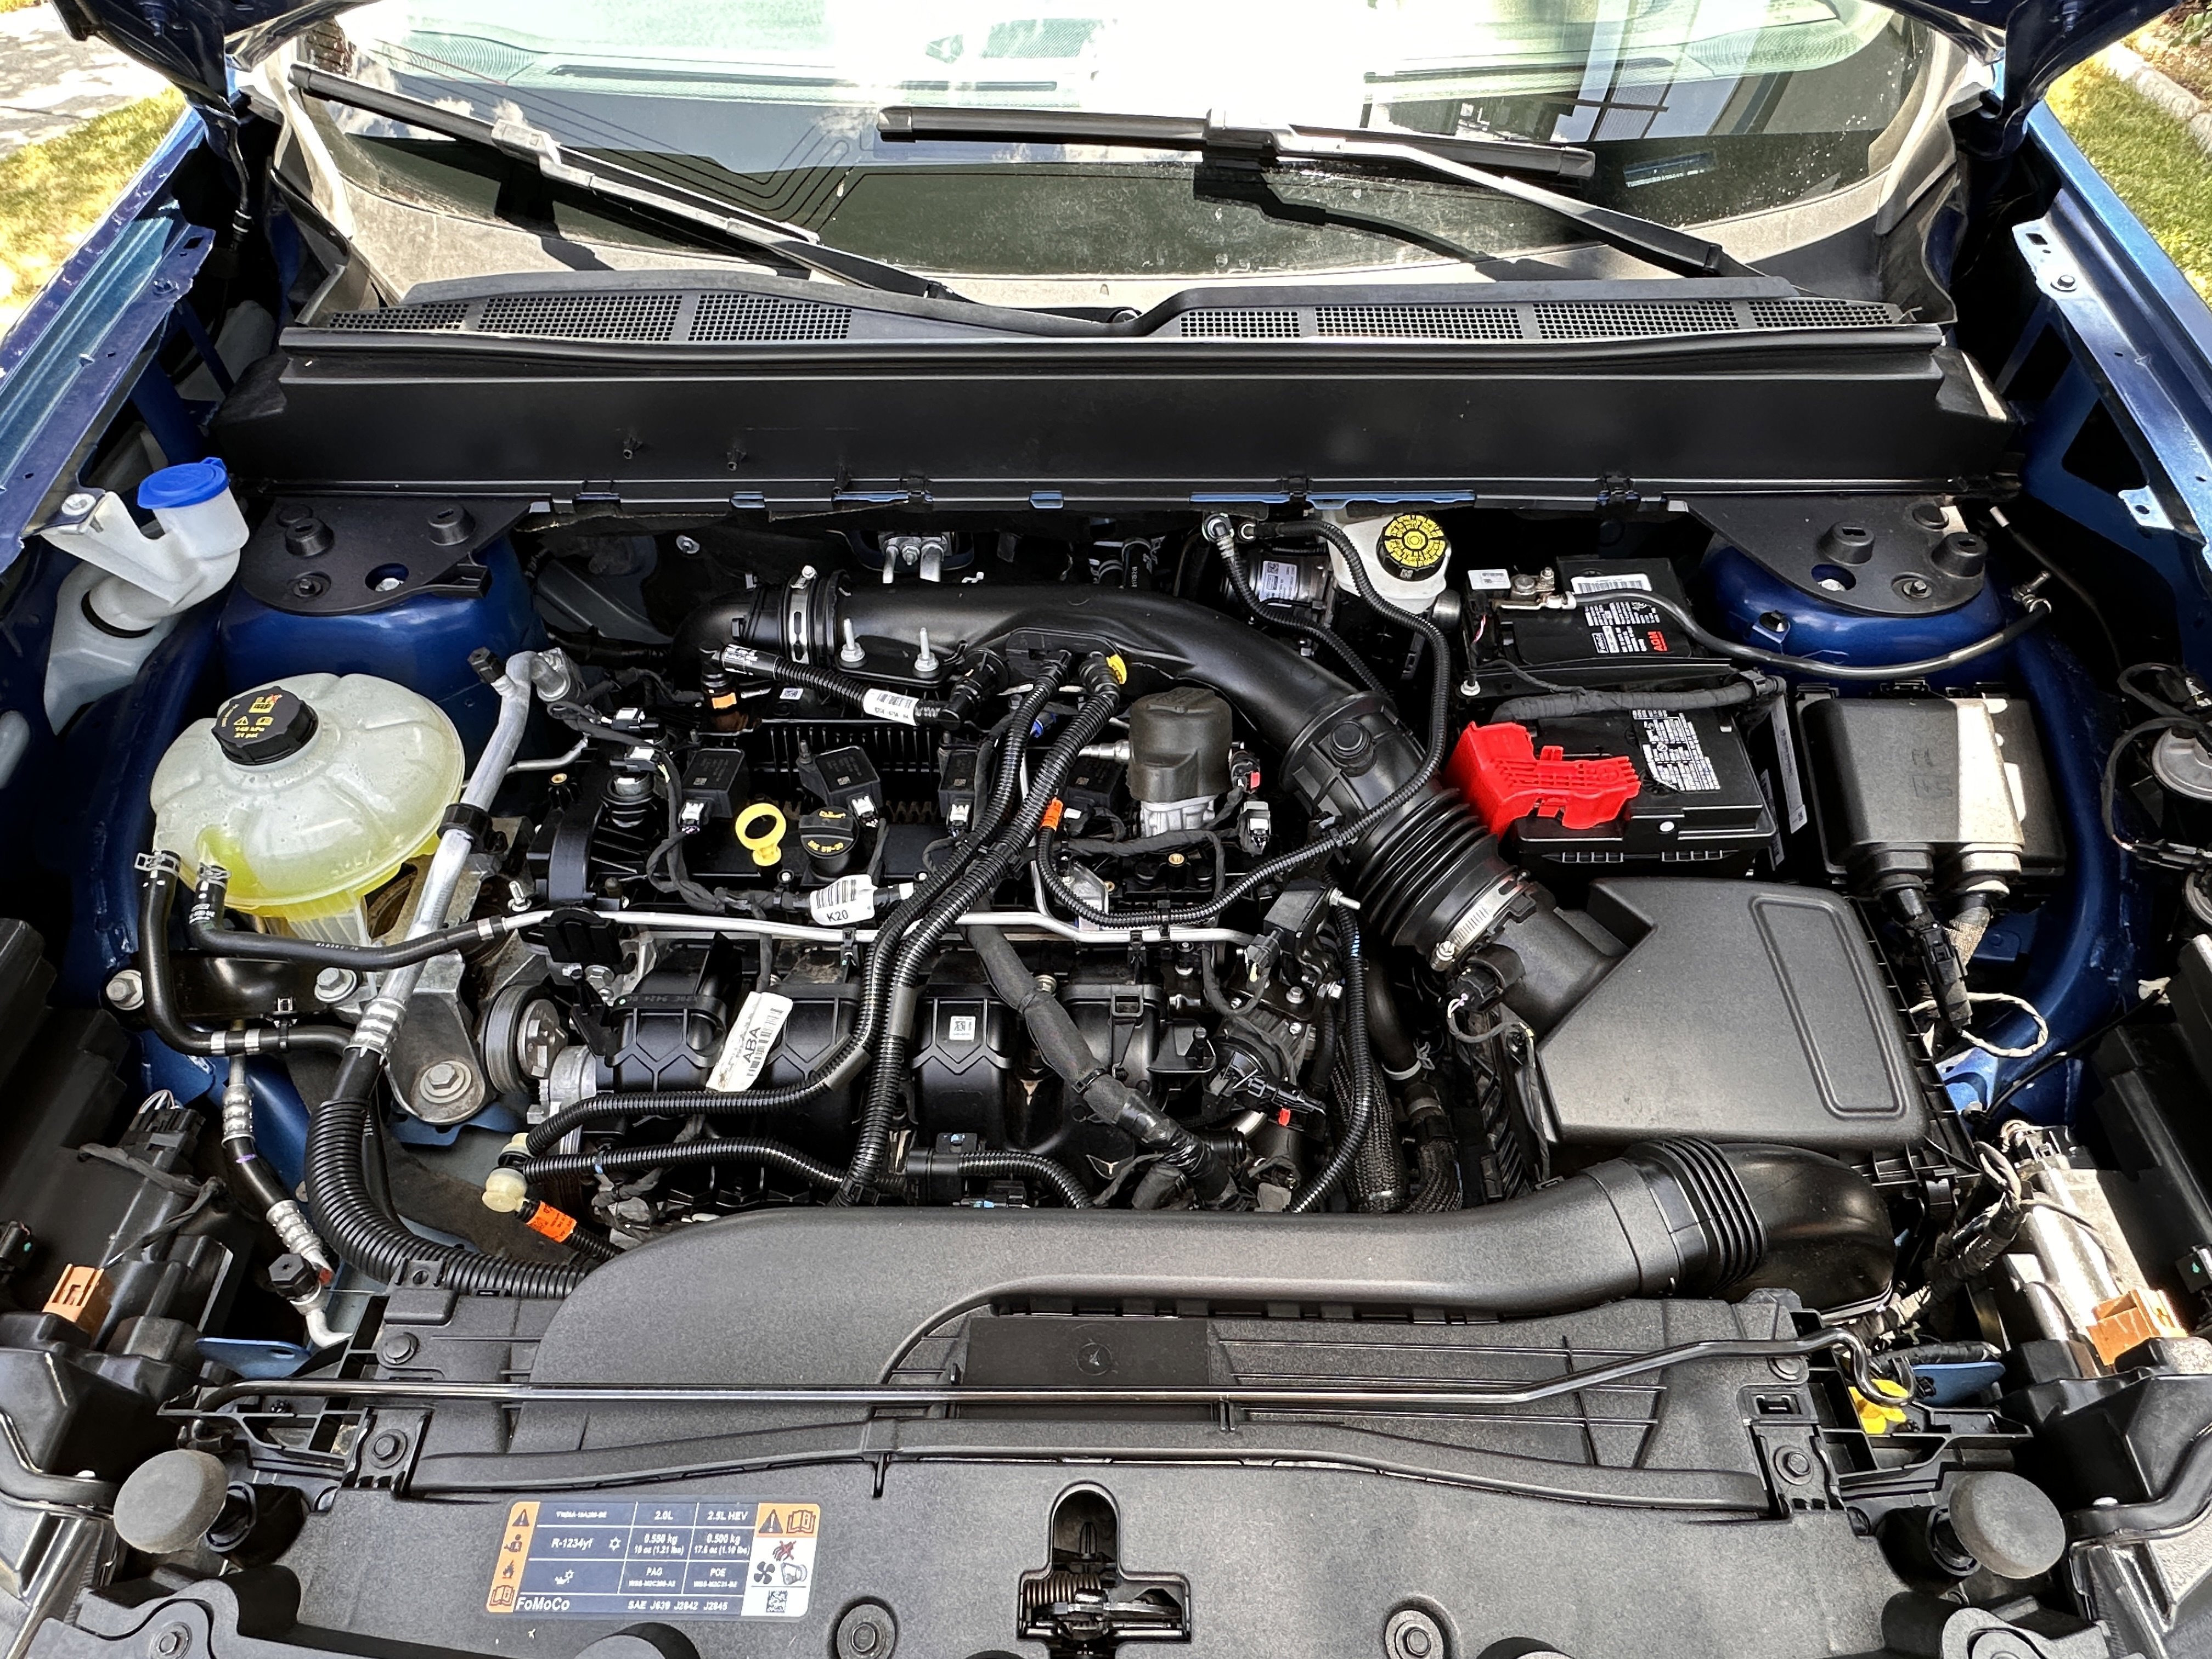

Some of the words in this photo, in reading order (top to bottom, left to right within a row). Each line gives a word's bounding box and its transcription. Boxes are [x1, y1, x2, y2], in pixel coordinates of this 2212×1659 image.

[826, 910, 849, 922] K20
[743, 1027, 761, 1063] ABA
[654, 1510, 674, 1520] 2.0L
[707, 1510, 726, 1521] 2.5L
[728, 1511, 748, 1521] HEV
[551, 1537, 594, 1550] R-1234yf
[667, 1533, 679, 1545] kg
[730, 1533, 741, 1546] kg
[516, 1596, 571, 1611] FoMoCo
[628, 1600, 647, 1610] SAE
